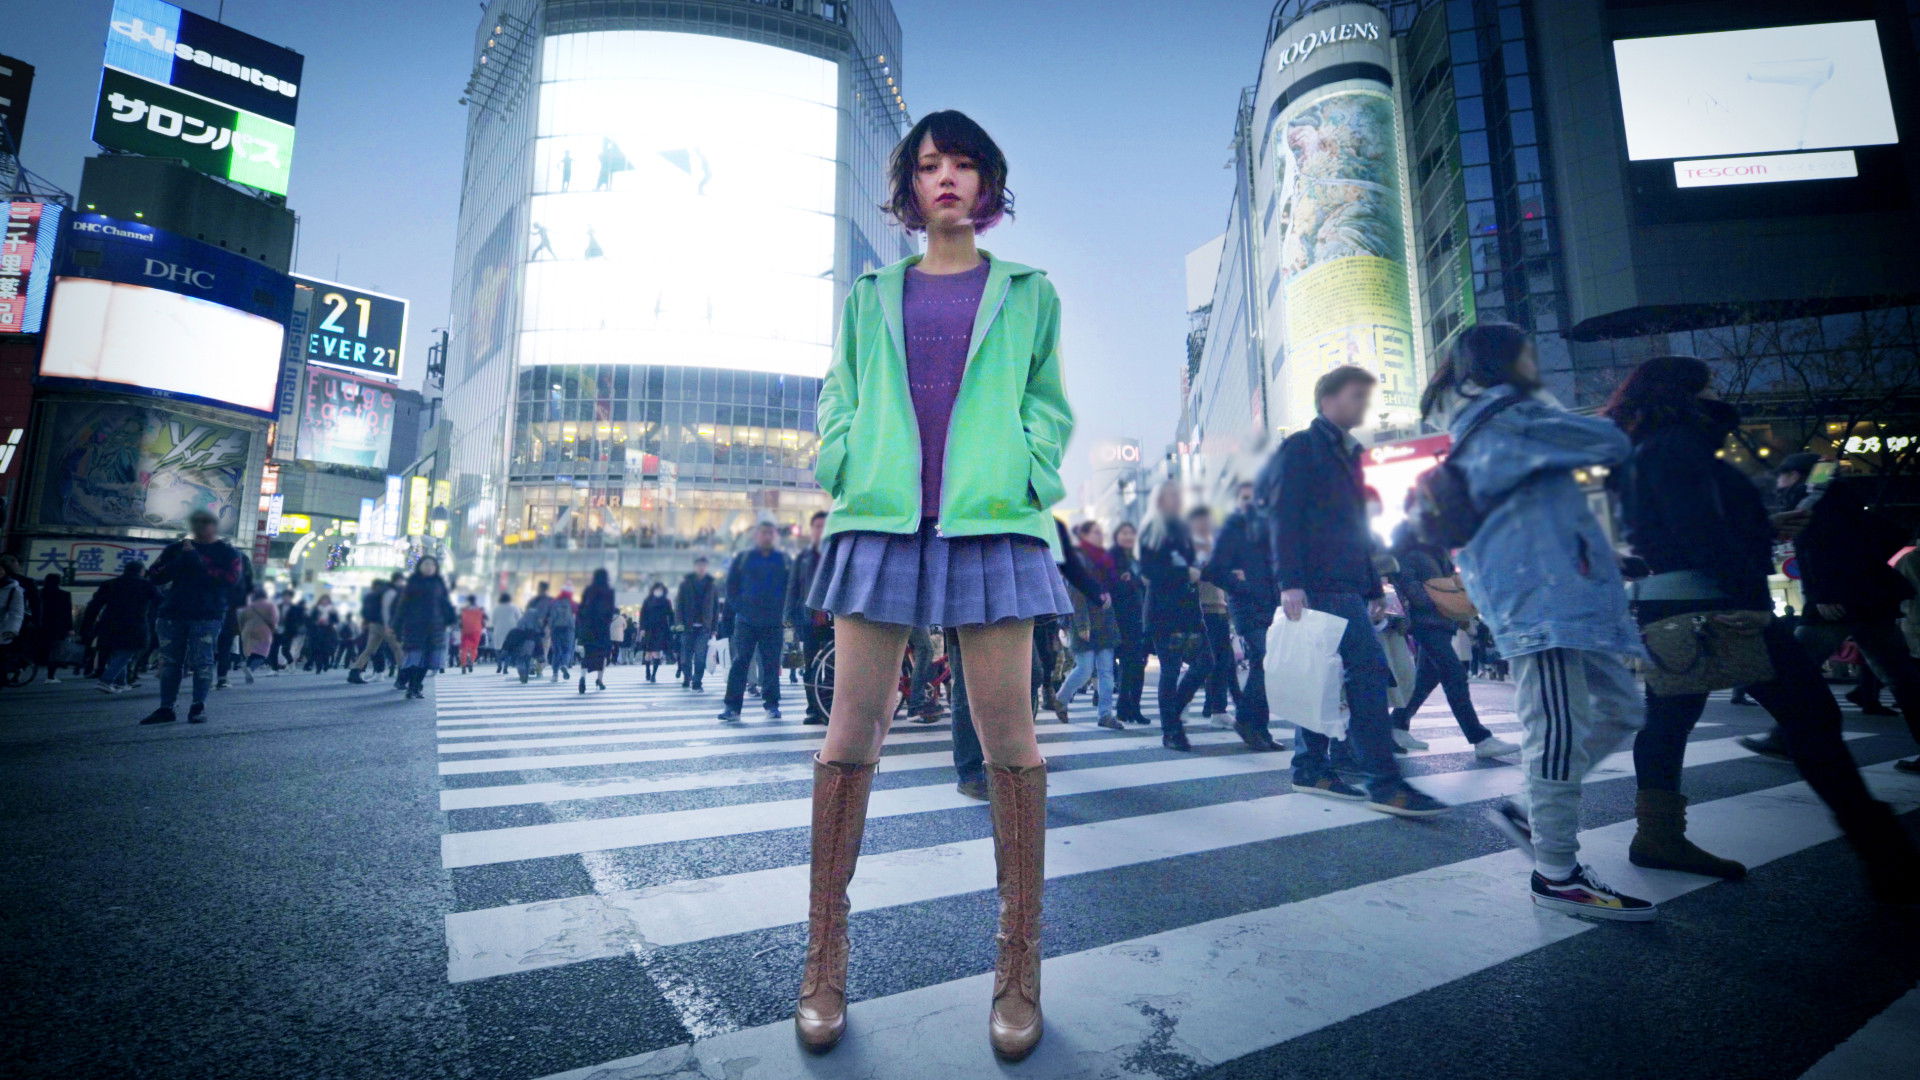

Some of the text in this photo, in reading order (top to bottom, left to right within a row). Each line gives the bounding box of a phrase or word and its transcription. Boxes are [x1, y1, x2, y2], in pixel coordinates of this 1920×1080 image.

[111, 17, 298, 98] Hisamitsu
[107, 92, 281, 169] サロンパス
[1686, 164, 1768, 180] TESCOM
[73, 220, 154, 243] DHC Channel
[142, 257, 216, 290] DHC
[319, 293, 371, 339] 21
[309, 333, 396, 368] EVER 21
[281, 366, 298, 415] neon
[307, 374, 393, 408] Fudge
[305, 395, 392, 429] Factor
